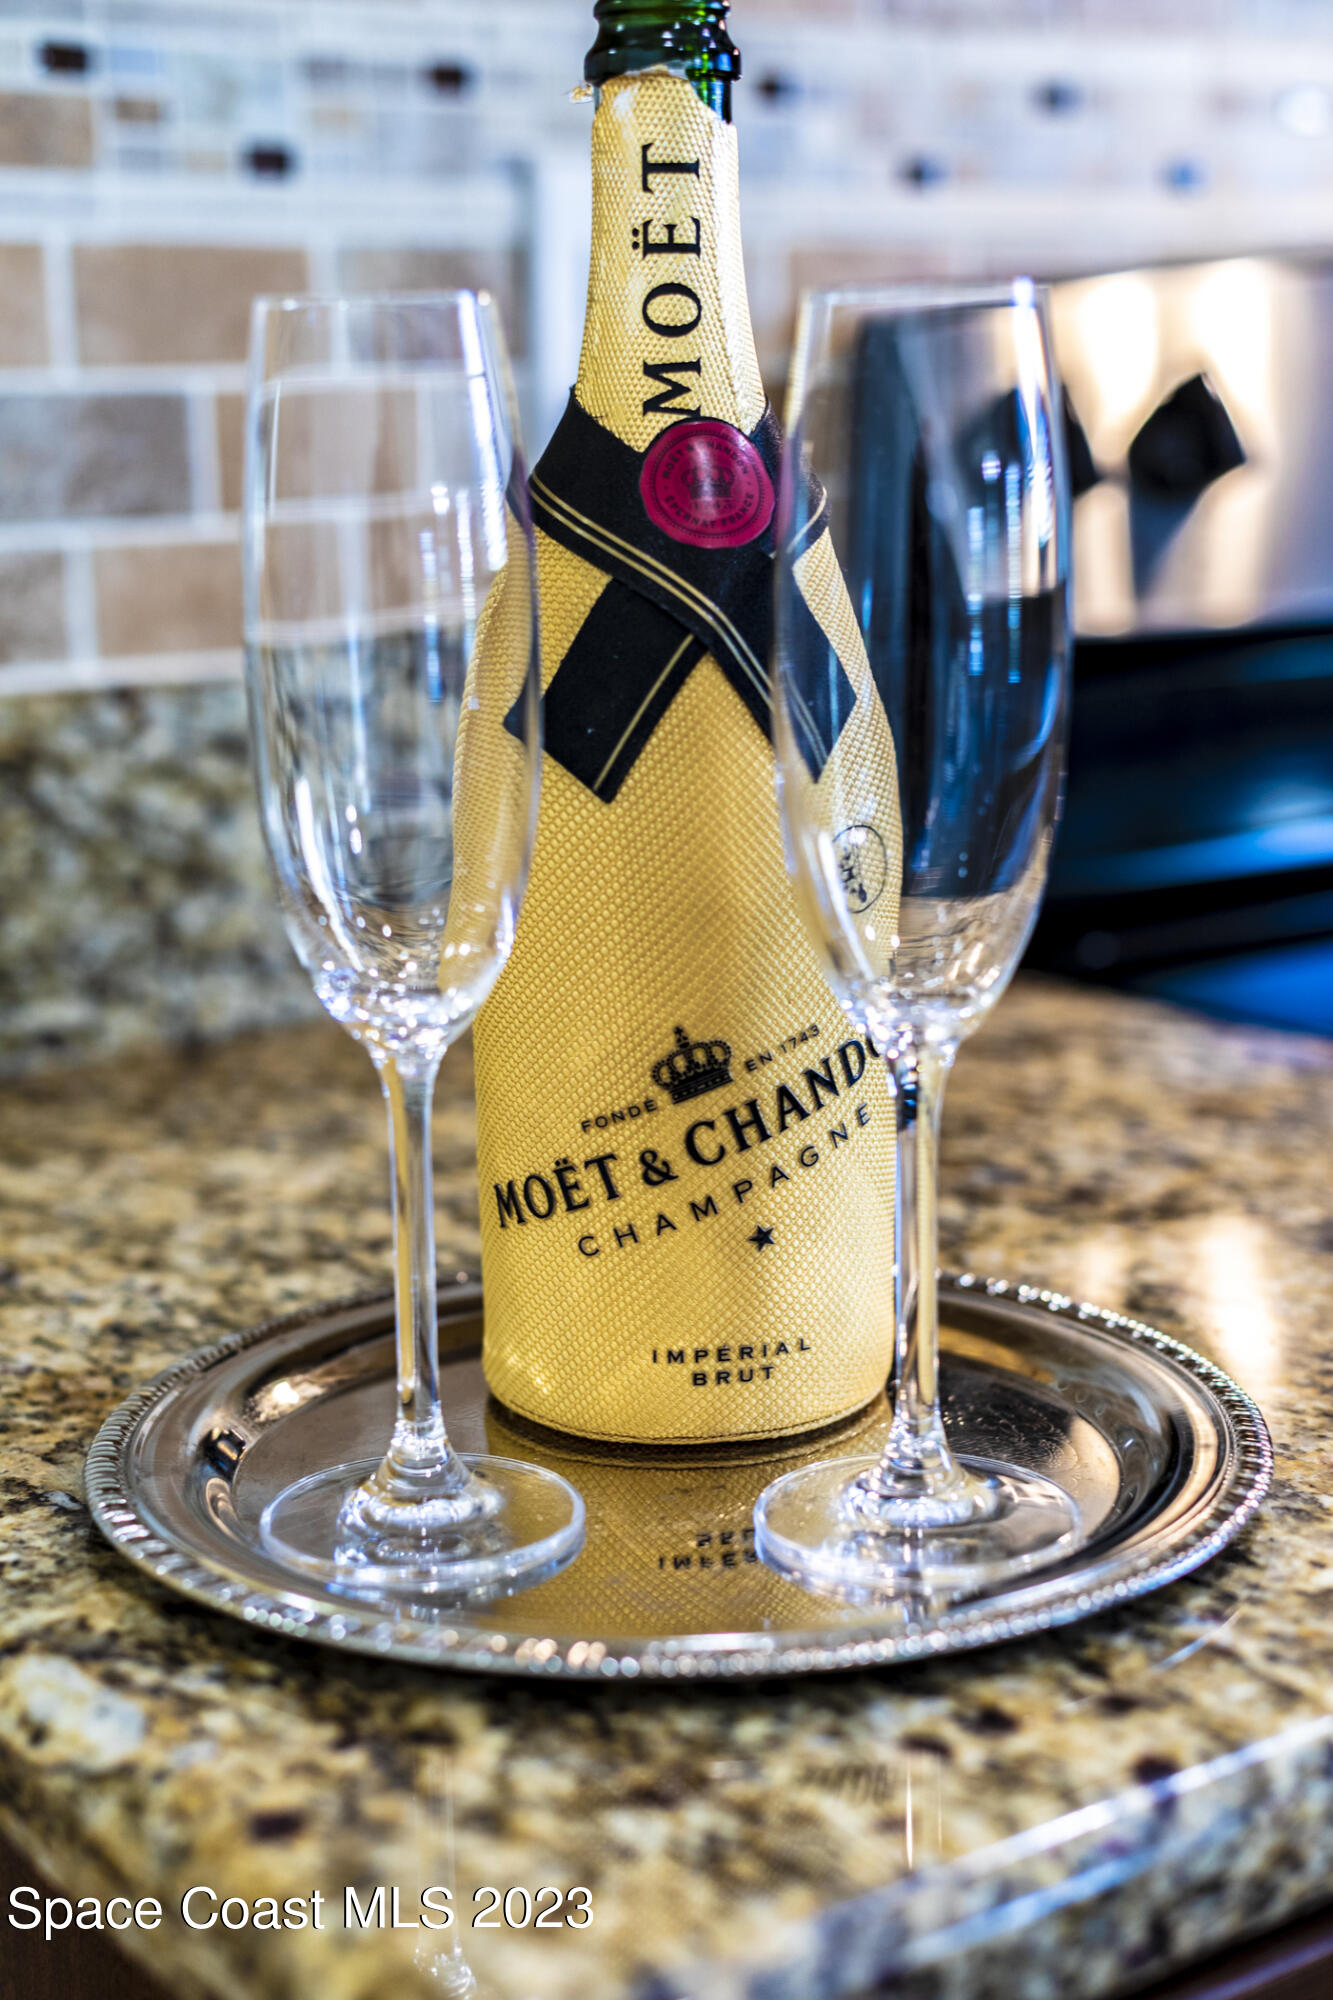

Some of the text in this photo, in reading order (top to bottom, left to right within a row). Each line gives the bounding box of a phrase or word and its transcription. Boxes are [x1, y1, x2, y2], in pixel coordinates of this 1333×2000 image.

[632, 142, 703, 417] MOËT
[697, 439, 749, 474] HANDON
[744, 1051, 774, 1073] EN
[779, 1024, 820, 1053] 1743
[493, 1037, 880, 1229] MOËT & CHAND
[578, 1103, 871, 1257] CHAMPAGNE
[652, 1338, 812, 1366] IMPÉRIAL
[692, 1366, 776, 1387] BRUT
